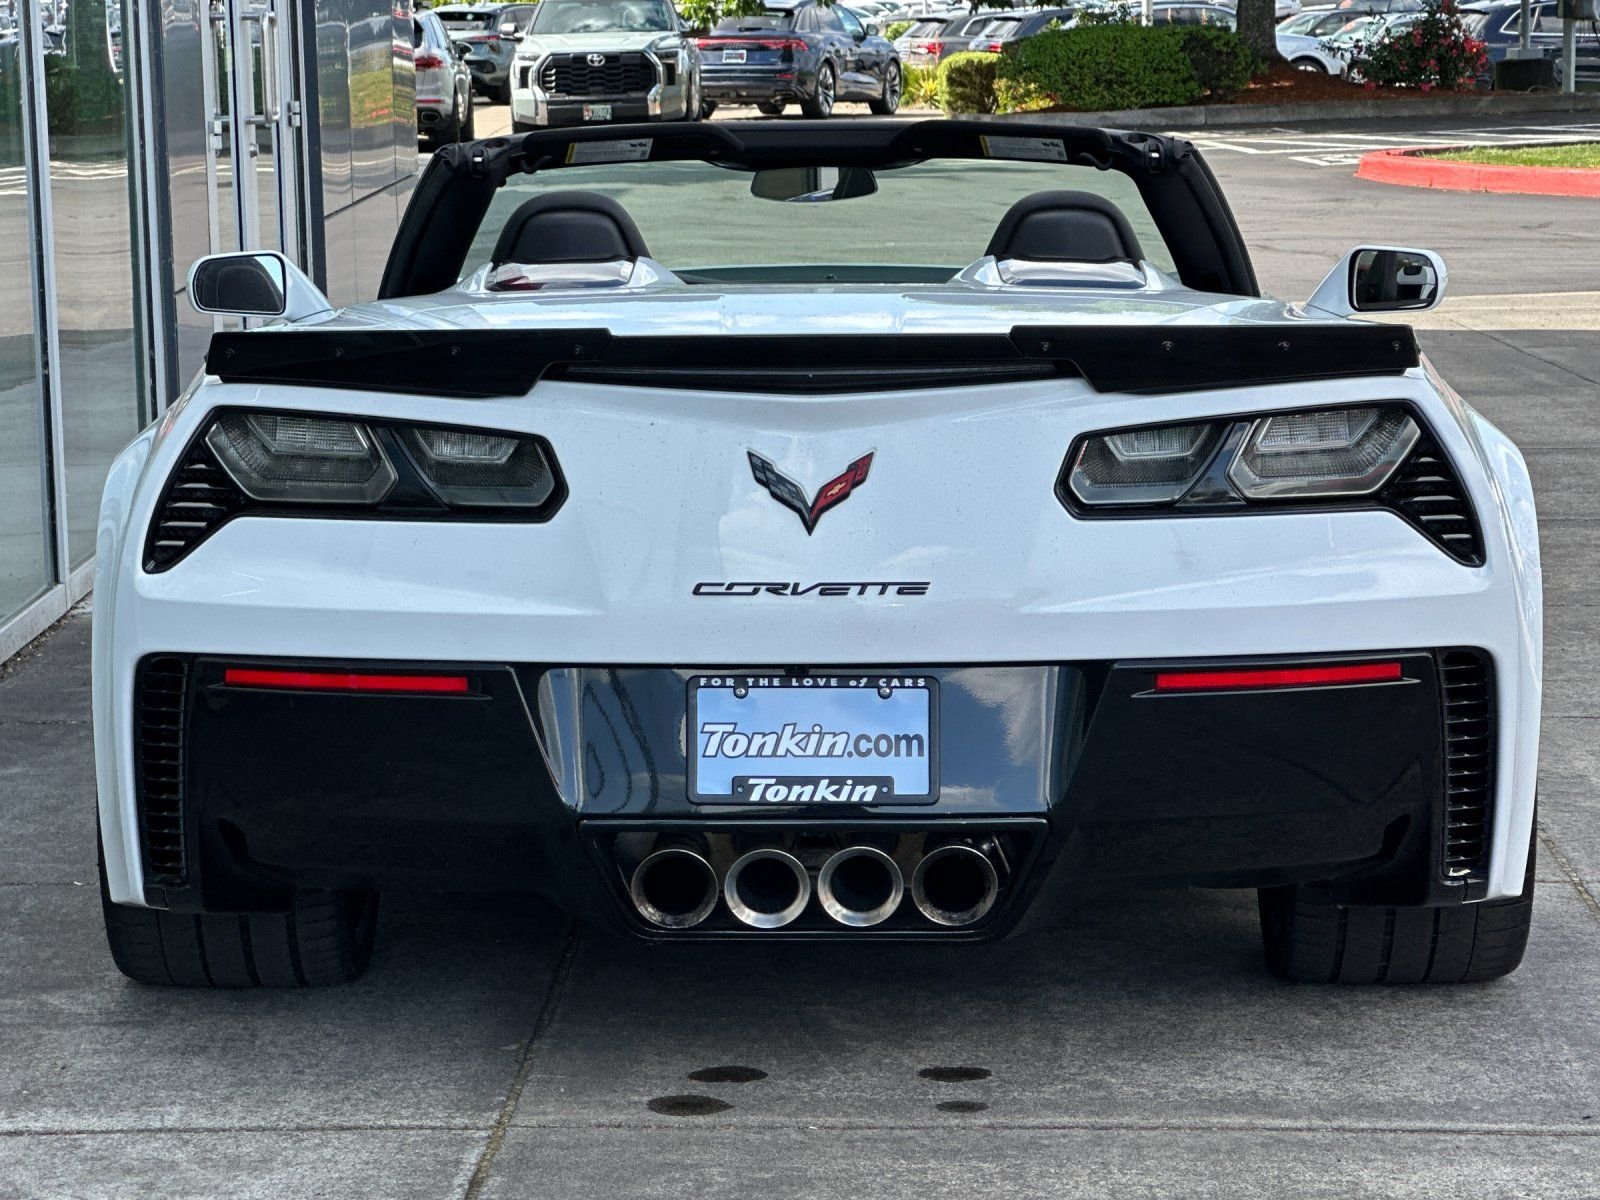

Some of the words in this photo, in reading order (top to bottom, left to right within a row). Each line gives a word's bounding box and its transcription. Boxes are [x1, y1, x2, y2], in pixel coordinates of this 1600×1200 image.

[692, 582, 931, 596] CORVETTE
[700, 677, 735, 687] FOR
[747, 677, 781, 687] THE
[791, 677, 838, 687] LOVE
[849, 677, 868, 687] of
[878, 677, 926, 687] CARS
[701, 722, 925, 758] Tonkin.com
[748, 778, 878, 802] Tonkin
